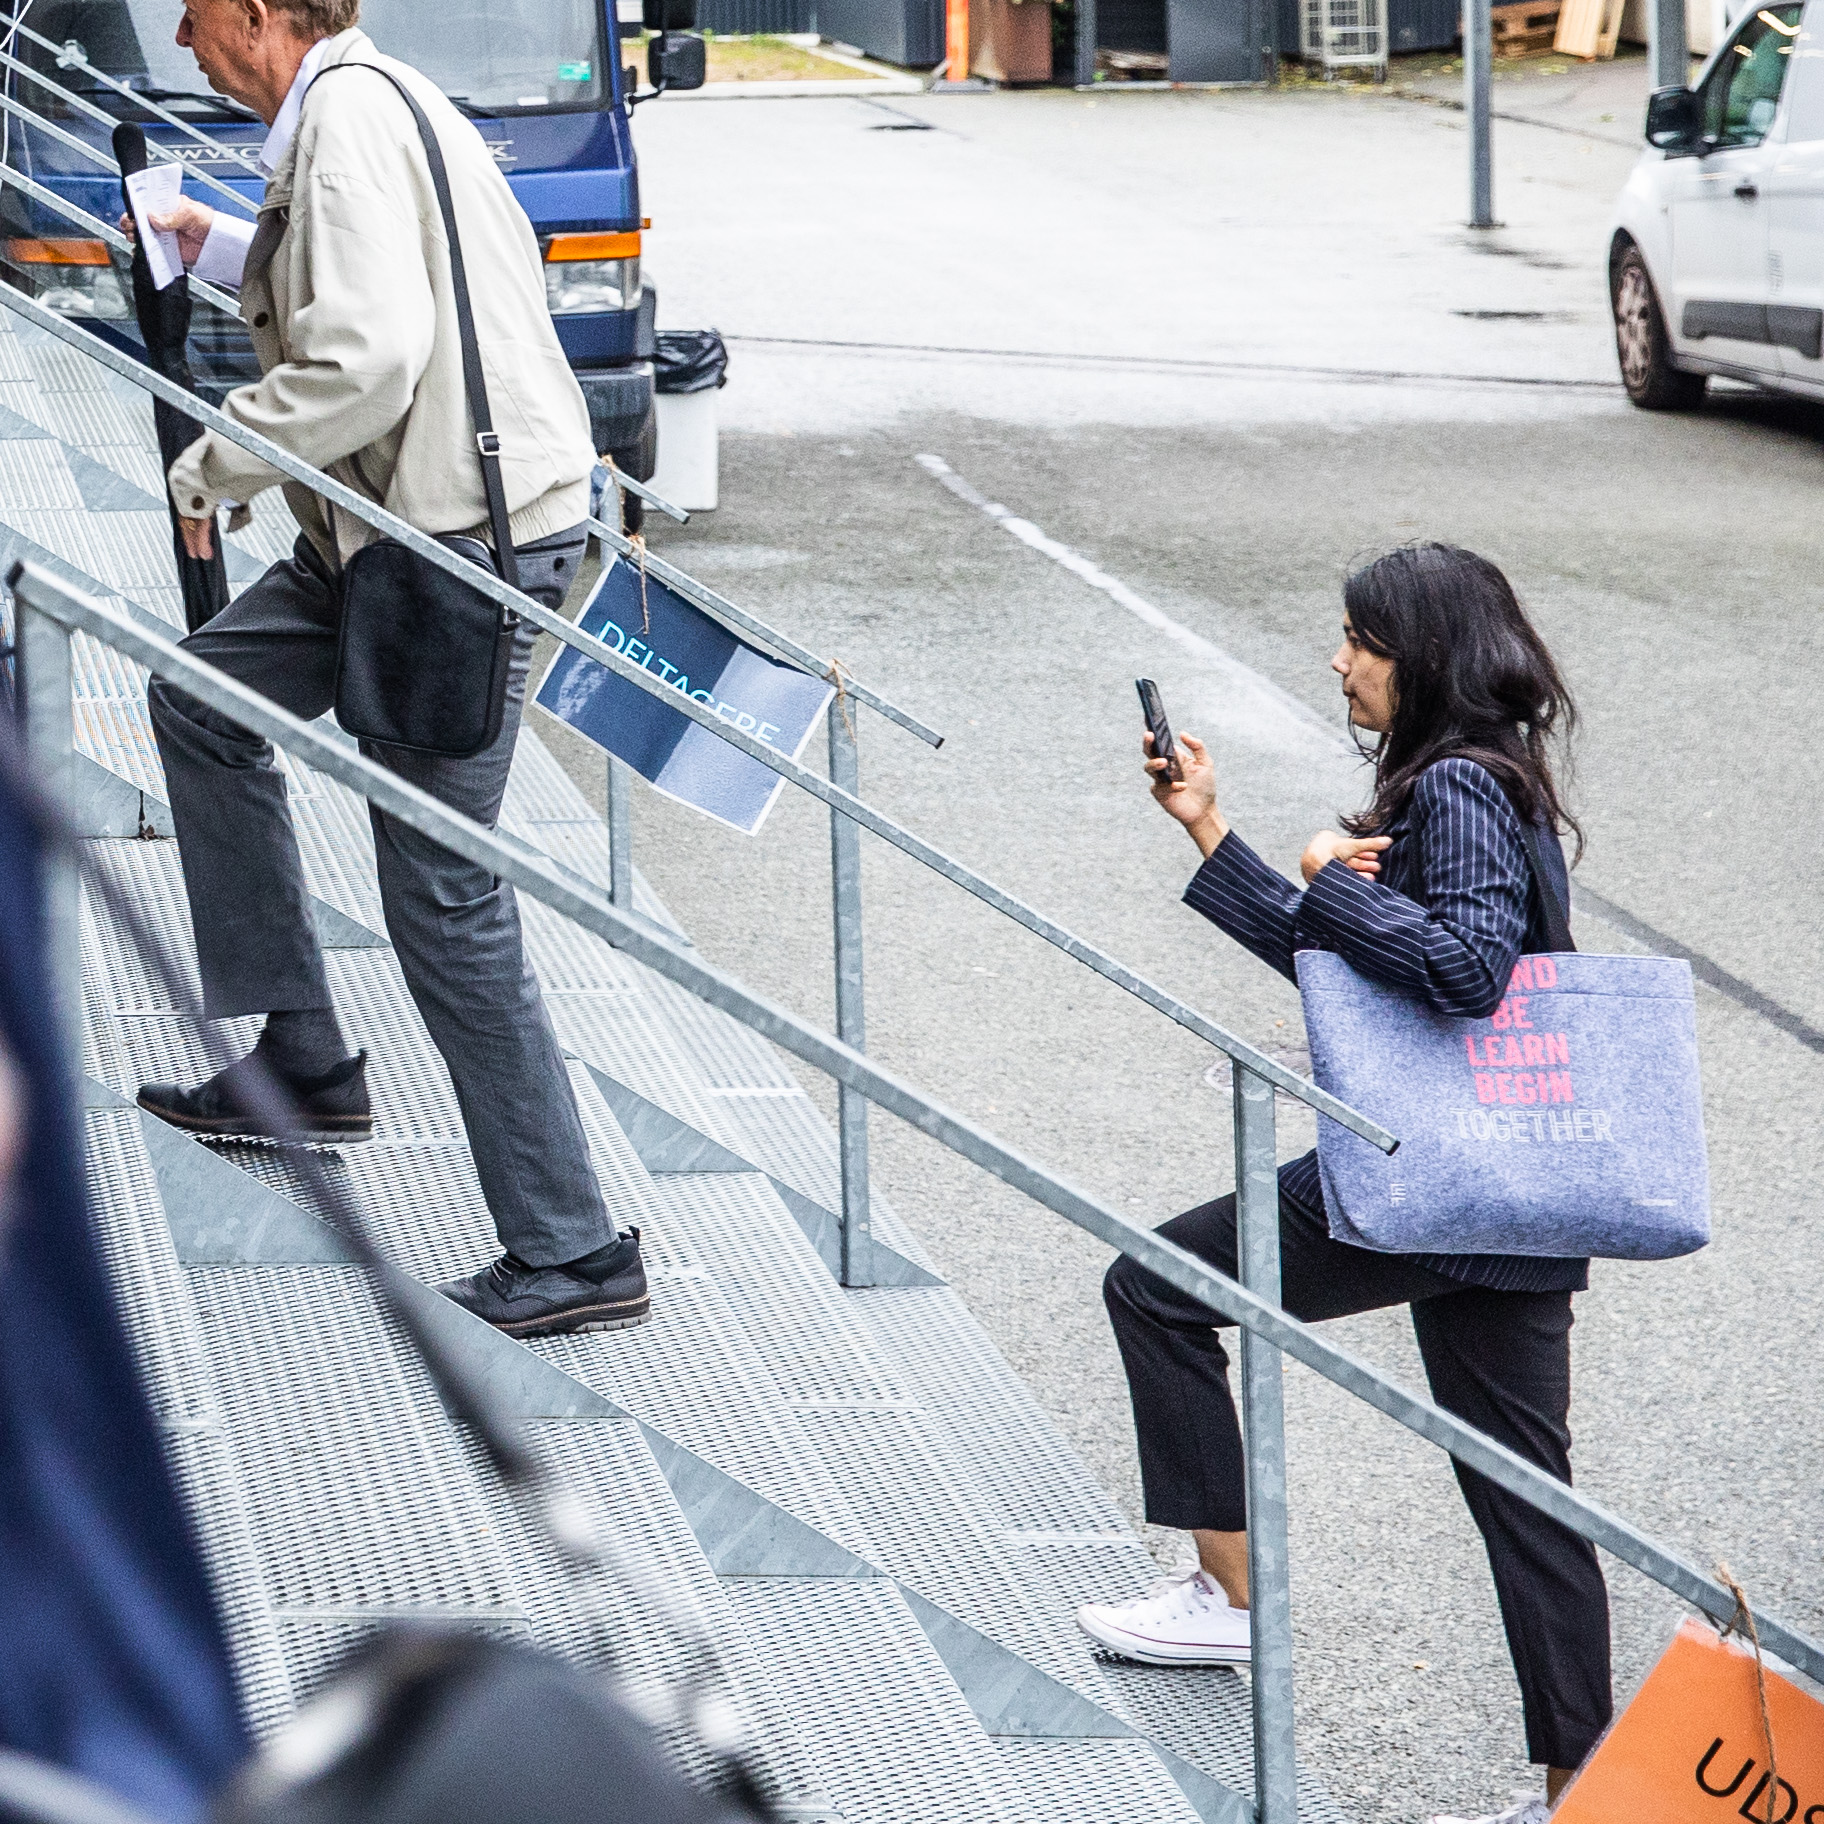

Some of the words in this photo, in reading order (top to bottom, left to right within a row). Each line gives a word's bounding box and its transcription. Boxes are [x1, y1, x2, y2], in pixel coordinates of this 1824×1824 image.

[1505, 955, 1559, 993] ND
[1491, 996, 1534, 1030] BE
[1465, 1032, 1571, 1067] LEARN
[1474, 1070, 1575, 1105] BEGIN
[1449, 1107, 1615, 1143] TOGETHER
